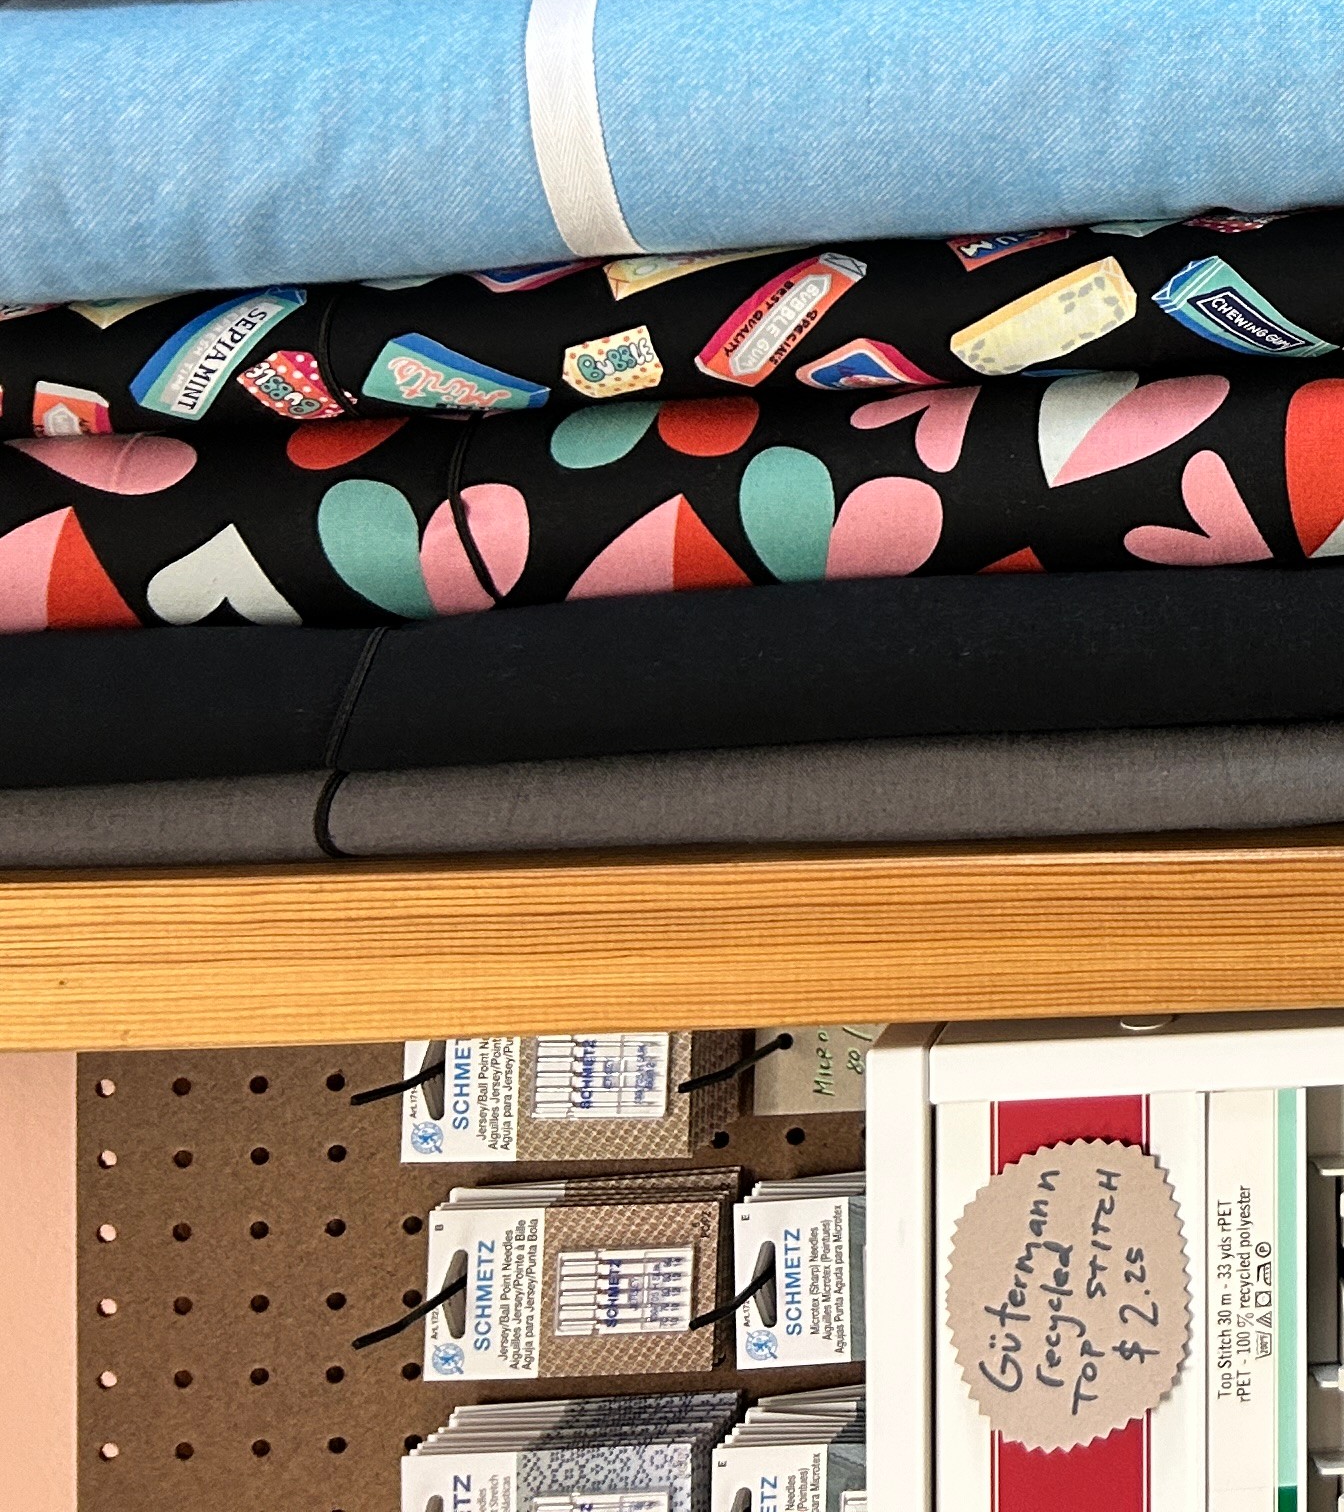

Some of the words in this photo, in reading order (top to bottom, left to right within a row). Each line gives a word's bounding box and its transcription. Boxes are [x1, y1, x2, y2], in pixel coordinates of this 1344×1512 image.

[762, 280, 796, 309] BEST
[769, 279, 822, 339] BUBBLE
[203, 307, 268, 369] SEPIA
[720, 309, 764, 358] QUALITY
[1210, 296, 1270, 341] CHEWING
[1266, 331, 1293, 351] GUM
[576, 335, 656, 384] BUBBLE
[743, 334, 772, 370] GUM
[177, 358, 217, 411] MINT
[245, 362, 324, 417] BUBBLE
[452, 1038, 472, 1131] SCHMET
[476, 1052, 490, 1079] Point
[579, 1039, 597, 1109] SCHMETZ
[475, 1082, 490, 1141] Jersey/Ball
[502, 1094, 514, 1118] para
[487, 1105, 502, 1151] Aiguilles
[500, 1120, 514, 1151] Aguja
[525, 1218, 539, 1242] Bola
[740, 1213, 751, 1222] E
[831, 1204, 844, 1243] Microtex
[1086, 1167, 1123, 1299] STITCH
[1217, 1198, 1233, 1233] rPET
[1236, 1184, 1255, 1248] polyester
[500, 1229, 514, 1272] Needles
[808, 1226, 820, 1263] Needles
[819, 1219, 834, 1263] (Pointues)
[834, 1243, 846, 1265] para
[1217, 1237, 1236, 1261] yds
[498, 1273, 512, 1302] Point
[510, 1253, 526, 1325] Jersey/Pointe
[522, 1244, 538, 1313] Jersey/Punta
[783, 1227, 804, 1337] SCHMETZ
[808, 1264, 822, 1296] (Sharp)
[820, 1264, 832, 1303] Microtex
[832, 1265, 846, 1295] Aguda
[978, 1169, 1061, 1393] Gütermann
[1217, 1262, 1233, 1280] 33
[1236, 1251, 1255, 1310] recycled
[473, 1239, 496, 1352] SCHMETZ
[605, 1258, 623, 1328] SCHMETZ
[833, 1296, 845, 1323] Punta
[1220, 1292, 1233, 1306] m
[497, 1303, 512, 1362] Jersey/Ball
[523, 1314, 536, 1339] para
[808, 1296, 821, 1336] Microtex
[820, 1304, 834, 1341] Aiguilles
[1035, 1239, 1088, 1388] recycled
[1217, 1308, 1233, 1326] 30
[1236, 1311, 1255, 1329] %
[508, 1326, 524, 1371] Aiguilles
[520, 1340, 536, 1371] Aguja
[832, 1323, 847, 1354] Agujas
[1217, 1335, 1233, 1369] Stitch
[1236, 1330, 1252, 1354] 100
[1217, 1371, 1235, 1400] Top
[1236, 1370, 1252, 1404] rPET
[717, 1459, 728, 1469] E
[809, 1452, 822, 1492] Microtex
[784, 1474, 797, 1512] Needles
